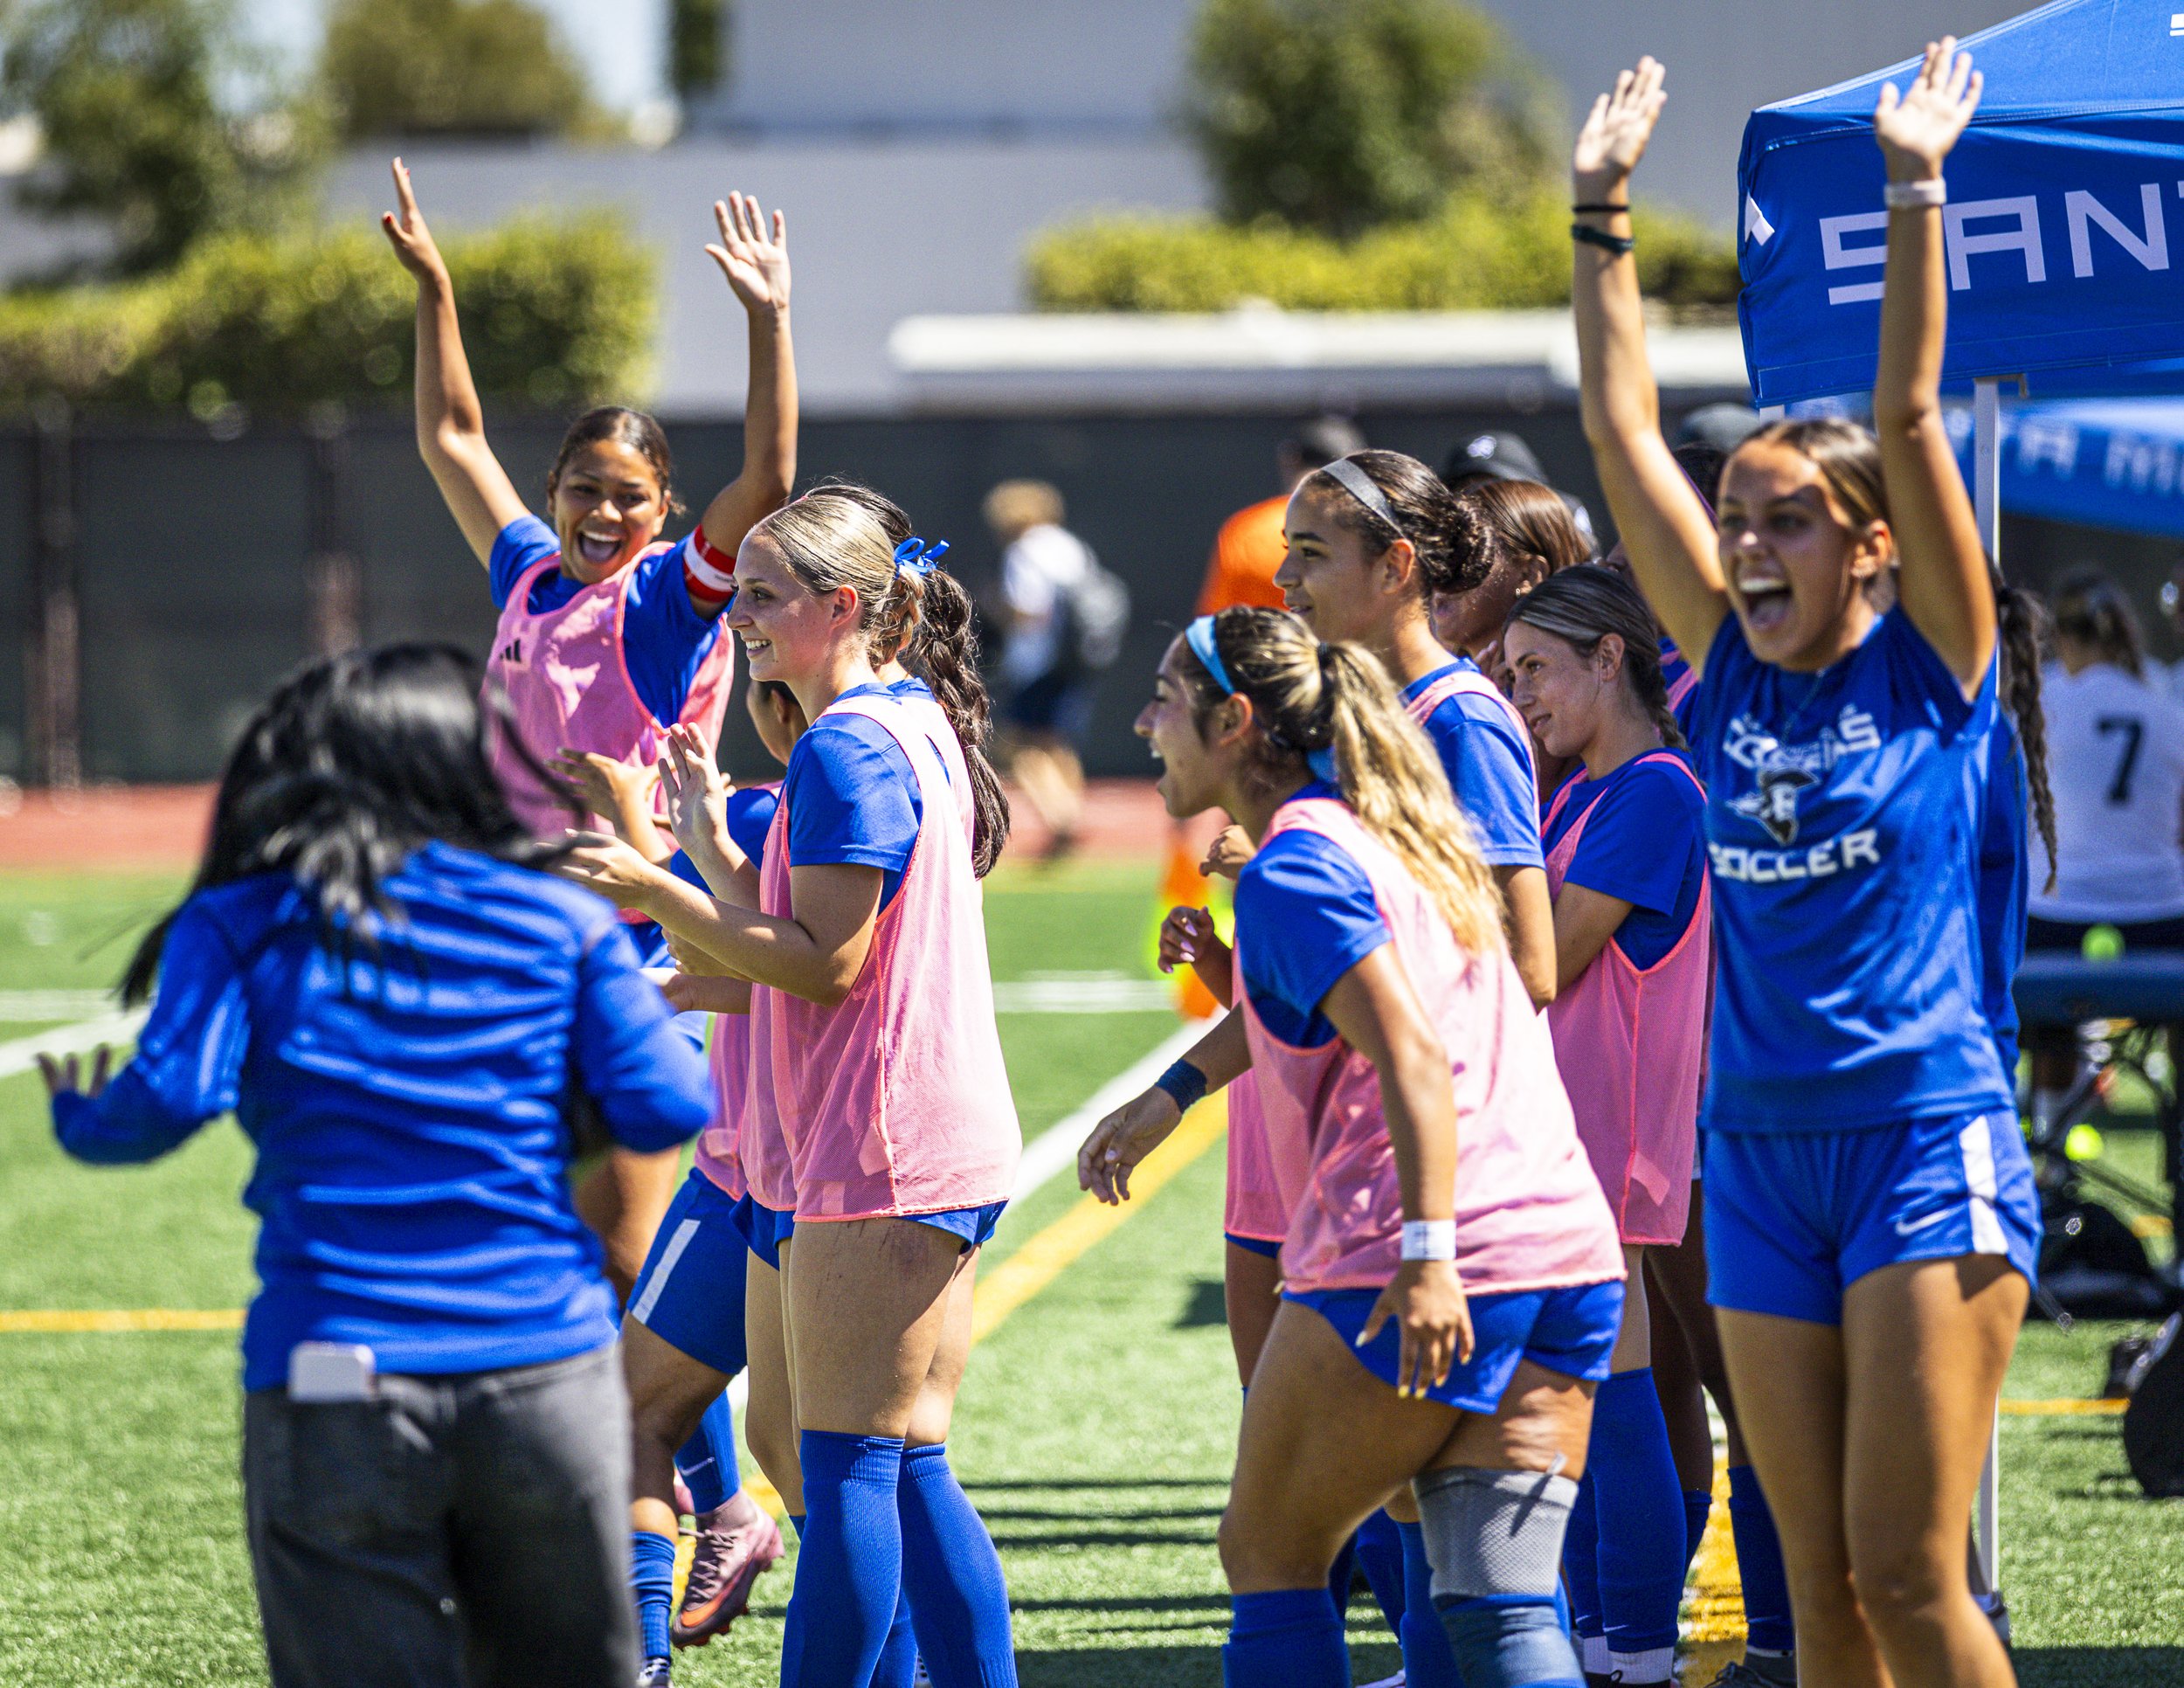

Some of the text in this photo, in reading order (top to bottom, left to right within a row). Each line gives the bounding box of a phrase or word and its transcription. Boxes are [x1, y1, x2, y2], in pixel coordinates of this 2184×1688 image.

[1819, 180, 2184, 305] SAN
[2098, 716, 2143, 805] 7
[1708, 828, 1880, 882] SOCCER
